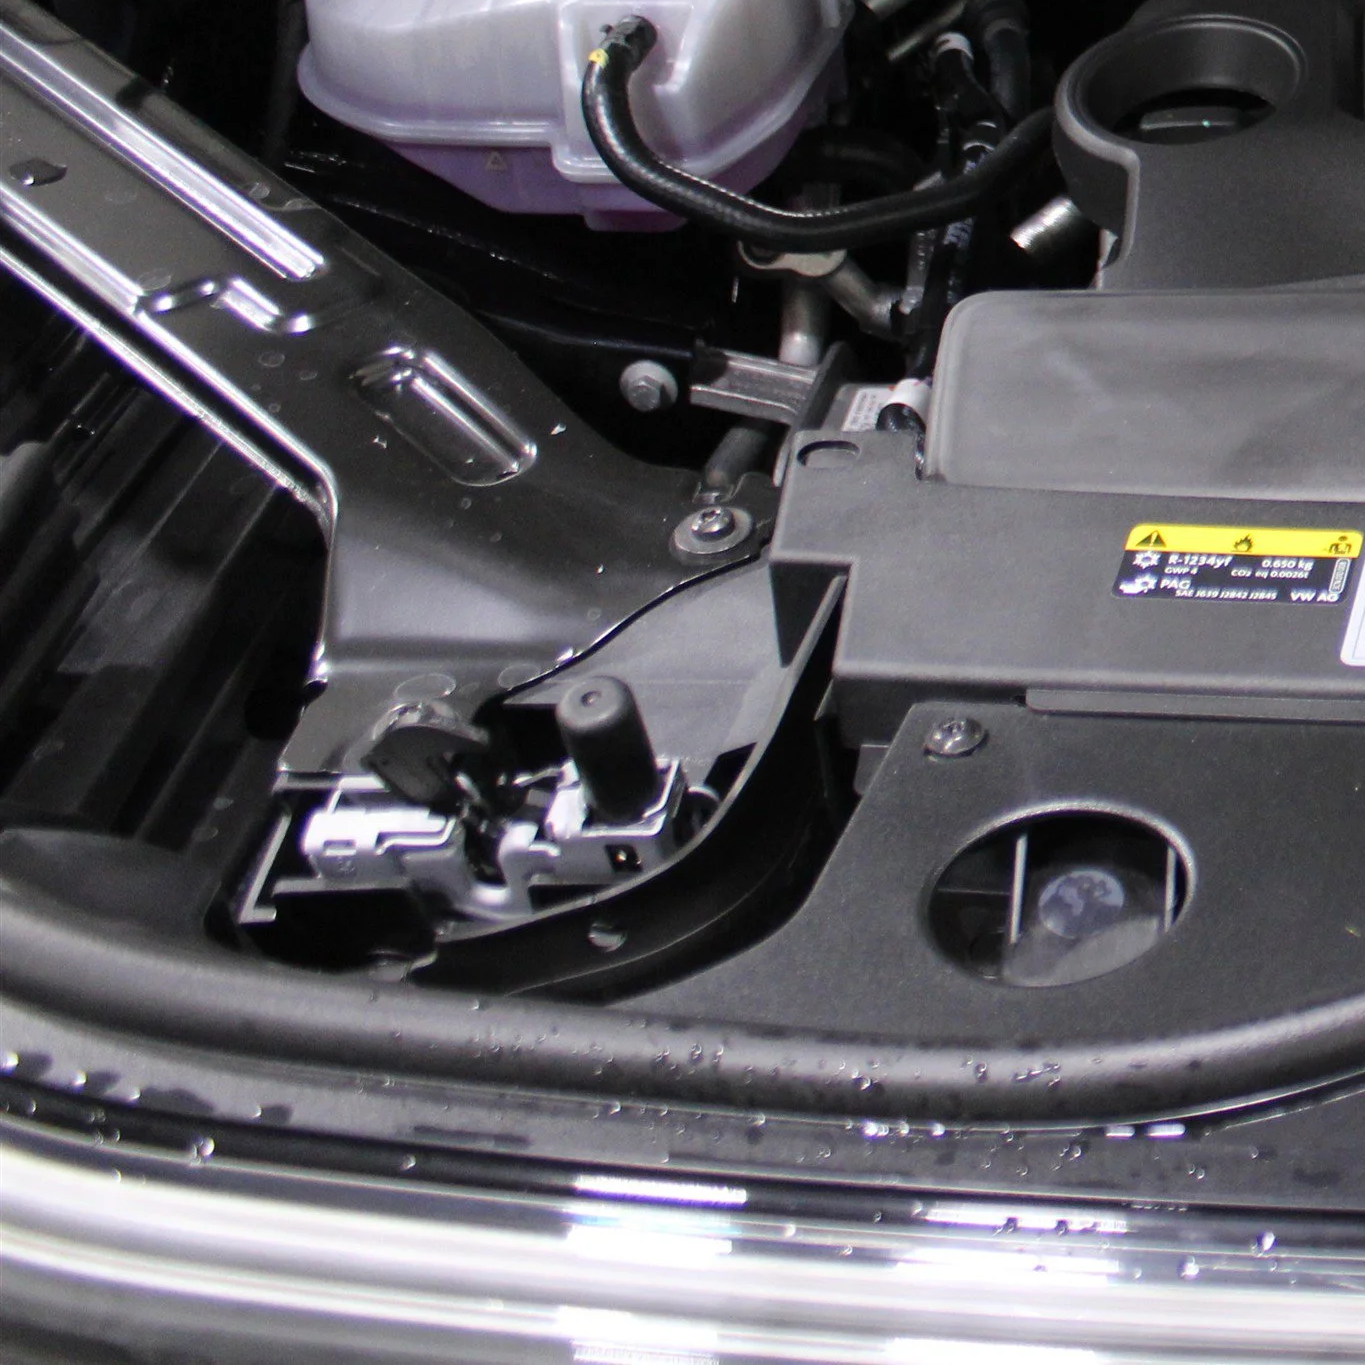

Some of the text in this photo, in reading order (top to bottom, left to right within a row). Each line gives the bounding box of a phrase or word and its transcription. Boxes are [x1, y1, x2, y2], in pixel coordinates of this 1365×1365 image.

[1168, 554, 1231, 569] R-1234yf
[1262, 559, 1314, 571] 0.650 kg
[1164, 566, 1198, 575] GWP 4
[1254, 570, 1268, 580] eq
[1160, 579, 1190, 590] PAG
[1175, 589, 1194, 597] SAE
[1290, 590, 1340, 601] VW AG
